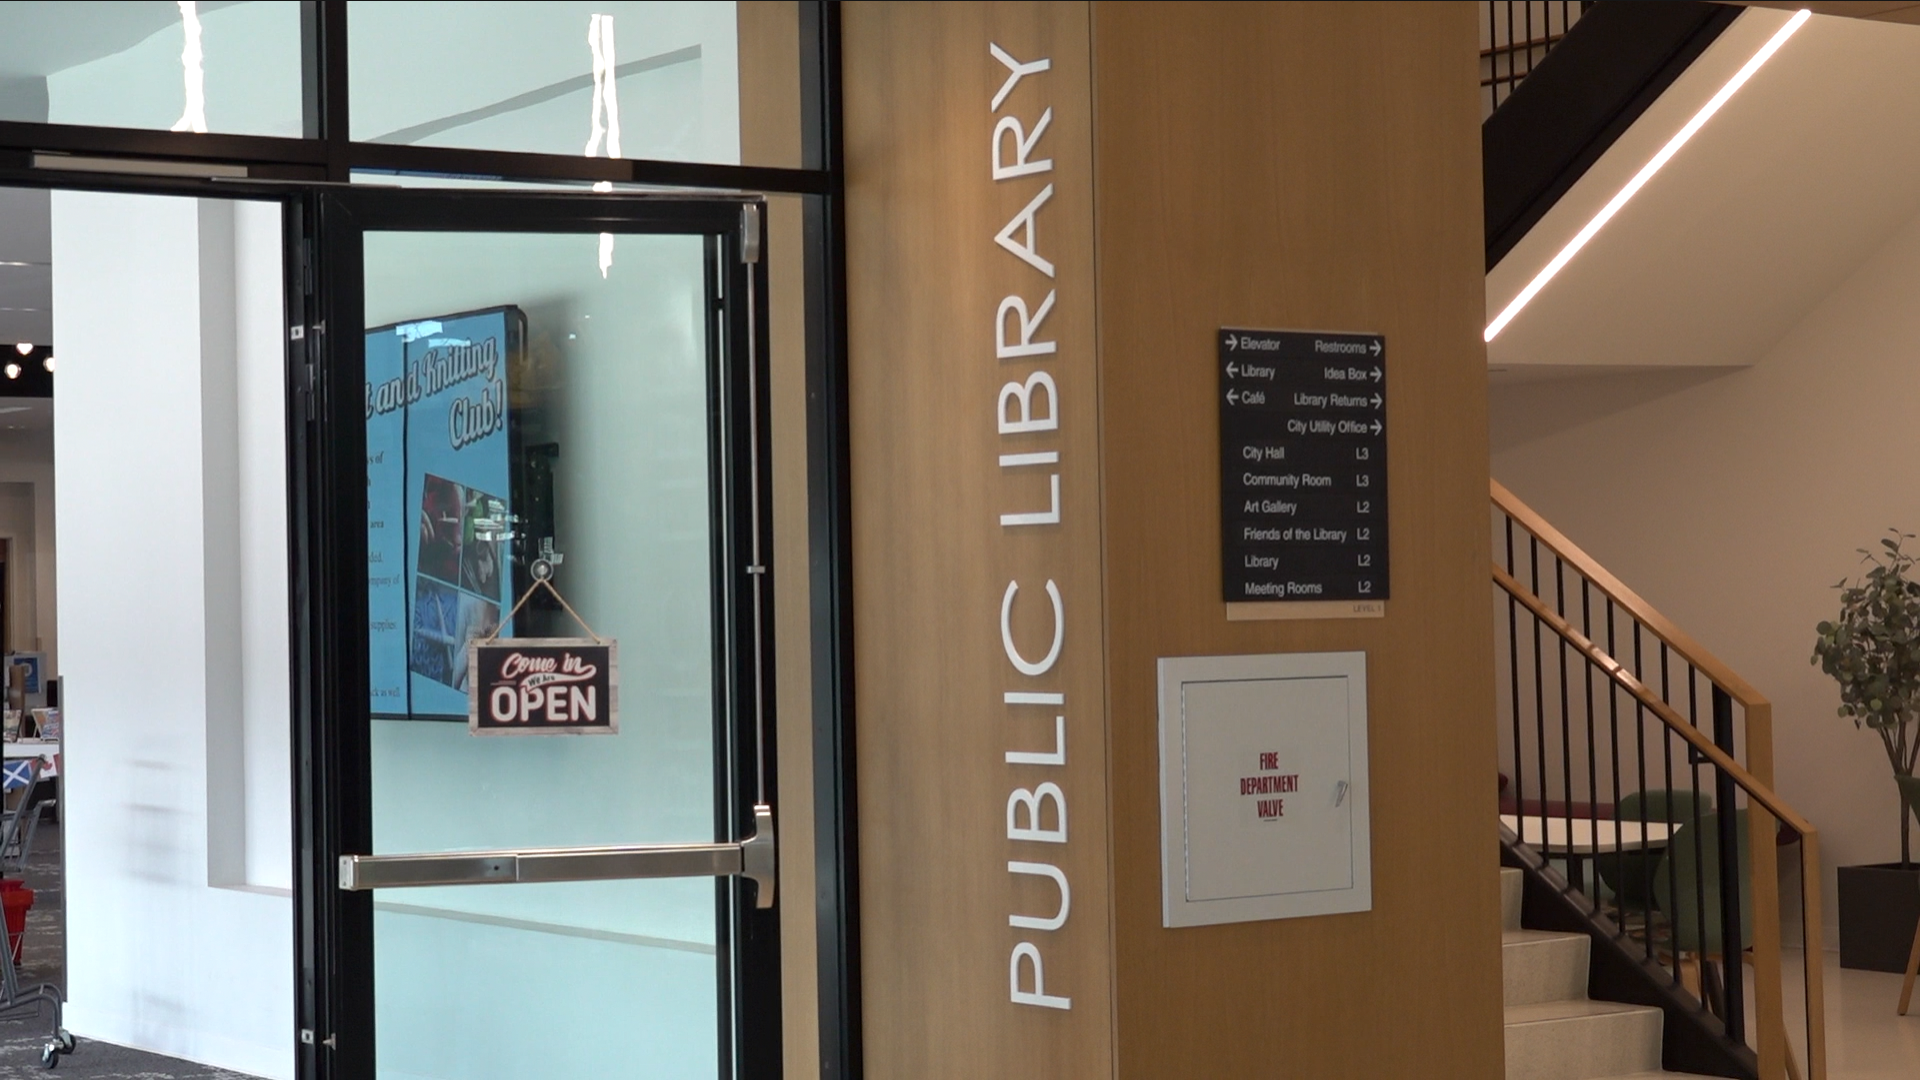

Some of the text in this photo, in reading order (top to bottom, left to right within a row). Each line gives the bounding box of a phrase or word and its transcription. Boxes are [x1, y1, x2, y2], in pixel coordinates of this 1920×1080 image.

[1240, 336, 1280, 351] Elevator
[1314, 339, 1367, 354] Restrooms
[375, 360, 421, 416] and
[422, 337, 498, 397] Knitting
[1241, 364, 1276, 381] Library
[1324, 367, 1368, 381] Idea Box
[1241, 389, 1266, 405] Café
[1294, 392, 1368, 409] Library Returns
[449, 380, 503, 451] Club!
[1287, 419, 1368, 436] City Utility Office
[1242, 446, 1285, 462] City Hall
[1356, 447, 1369, 460] L3
[1242, 472, 1332, 489] Community Room
[1356, 474, 1369, 487] L3
[1244, 499, 1297, 516] Art Gallery
[1356, 501, 1370, 513] L2
[990, 41, 1072, 1010] PUBLIC LIBRARY
[1244, 527, 1347, 543] Friends of the Library
[1356, 528, 1370, 540] L2
[1244, 554, 1279, 570] Library
[1357, 554, 1371, 567] L2
[1244, 582, 1323, 598] Meeting Rooms
[1358, 581, 1371, 594] L2
[1353, 604, 1375, 613] LEVEL
[501, 652, 591, 679] Come in
[528, 675, 541, 687] We
[491, 685, 597, 722] OPEN
[1260, 751, 1279, 771] FIRE
[1240, 774, 1299, 796] DEPARTMENT
[1257, 799, 1284, 819] VALVE
